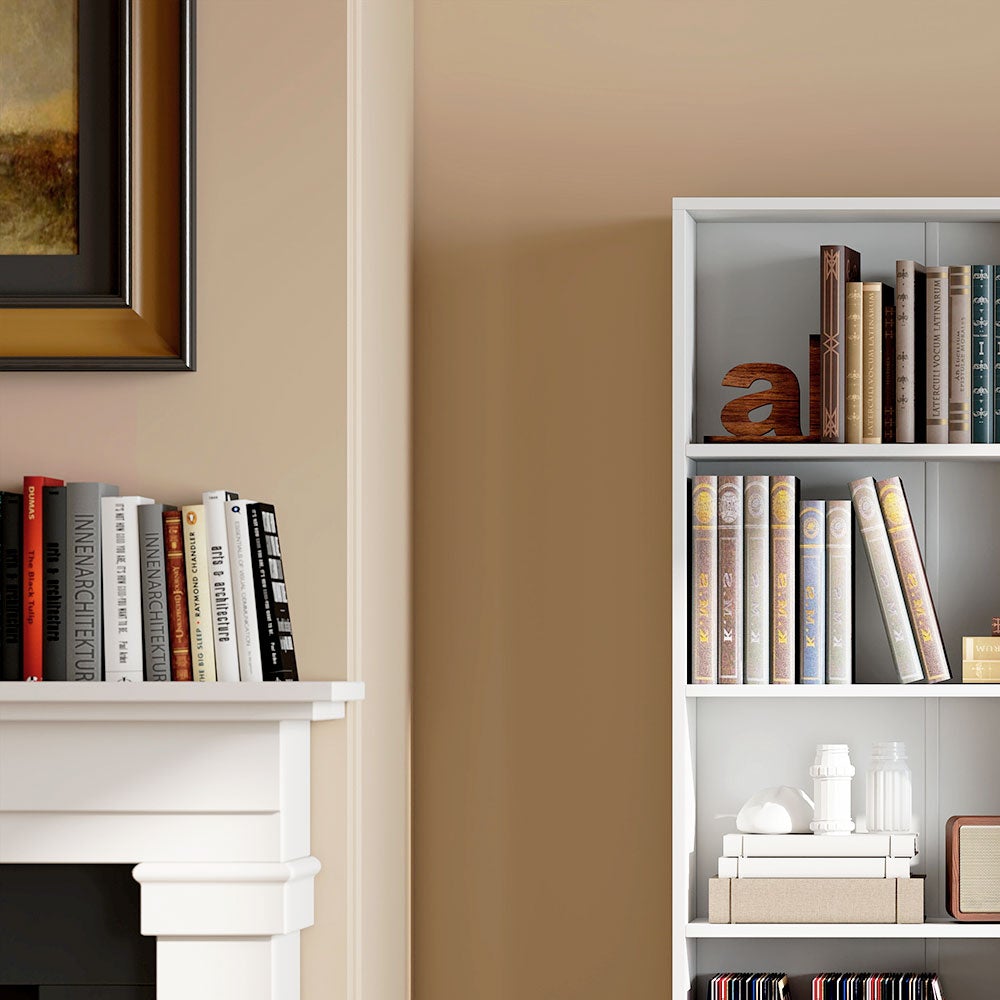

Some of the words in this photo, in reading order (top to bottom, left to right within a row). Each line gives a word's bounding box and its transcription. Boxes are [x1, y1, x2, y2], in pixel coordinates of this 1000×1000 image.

[867, 291, 875, 346] LATINARUM
[932, 280, 941, 332] LATINARUM
[932, 334, 941, 368] VOCUM
[932, 370, 941, 417] LATERCULI
[189, 532, 198, 573] CHANDLER
[211, 546, 224, 565] arts
[26, 601, 35, 625] Tulip
[46, 579, 62, 642] architecture
[74, 513, 95, 682] INNENARCHITEKTUR
[145, 532, 166, 682] INNENARCHITEKTUR
[192, 576, 201, 617] RAYMOND
[213, 582, 230, 643] architecture
[195, 628, 203, 650] SLEEP
